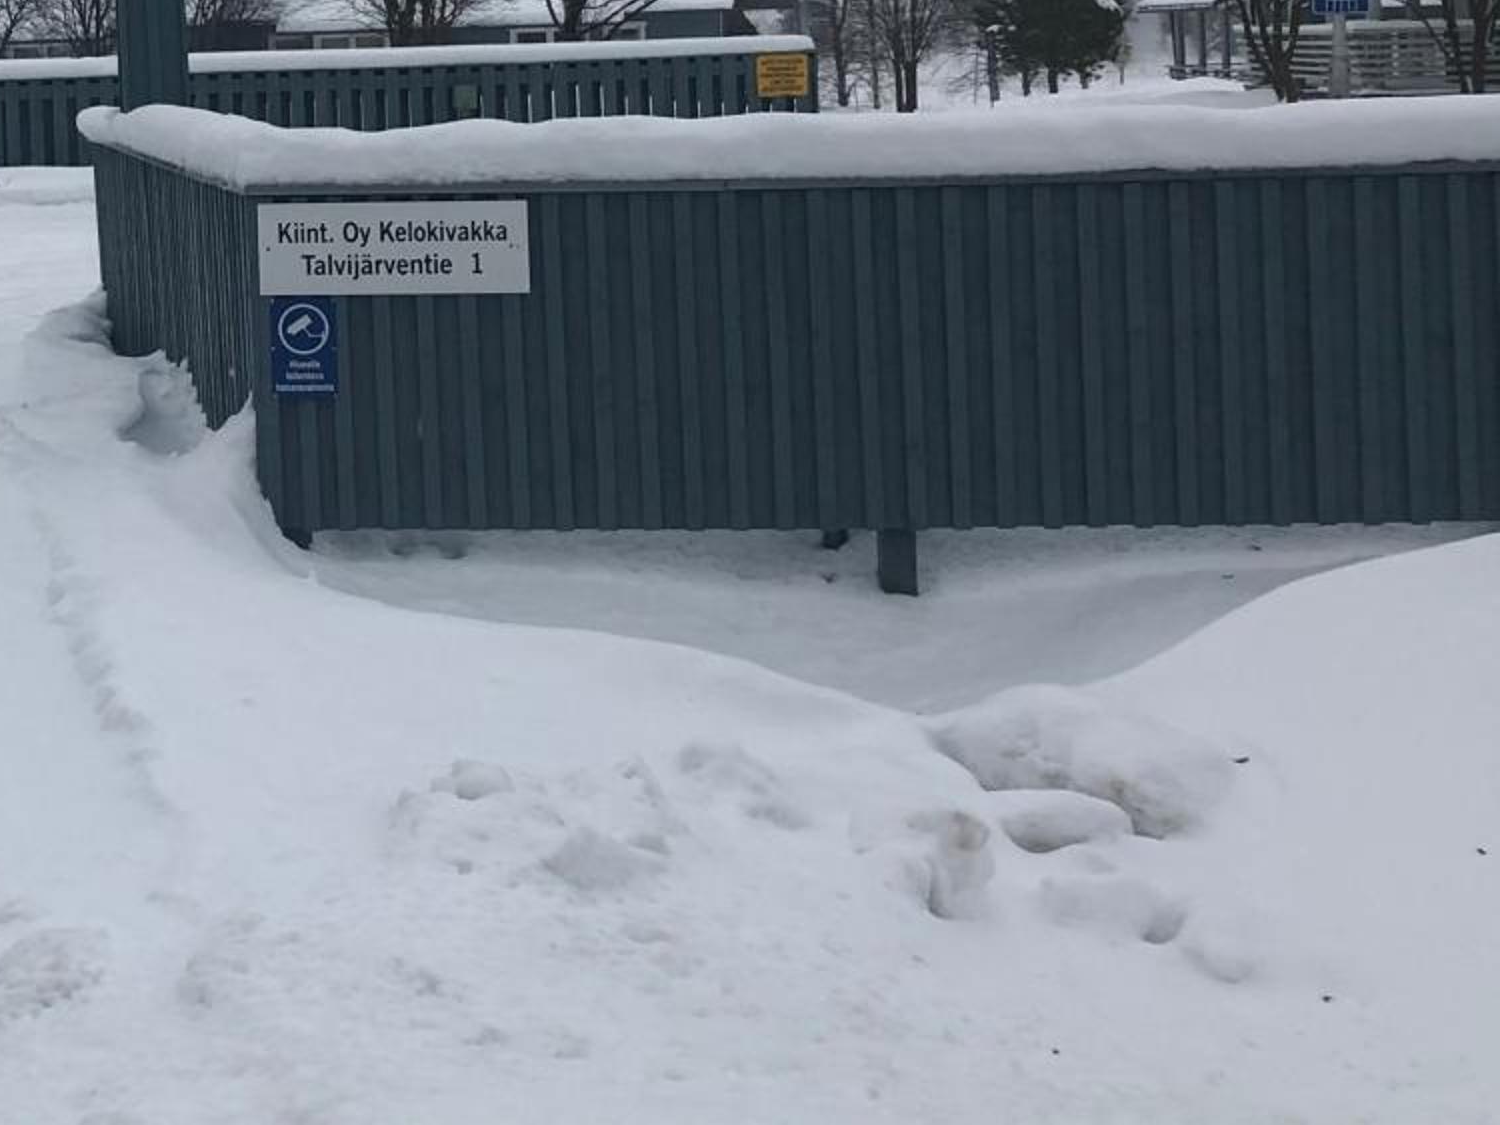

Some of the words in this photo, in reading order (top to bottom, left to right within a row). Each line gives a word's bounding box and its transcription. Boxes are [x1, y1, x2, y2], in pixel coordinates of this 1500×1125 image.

[277, 221, 335, 244] Kiint.
[342, 221, 371, 247] Oy
[379, 219, 508, 243] Kelokivakka
[301, 253, 453, 280] Talvijärventie
[471, 252, 484, 274] 1
